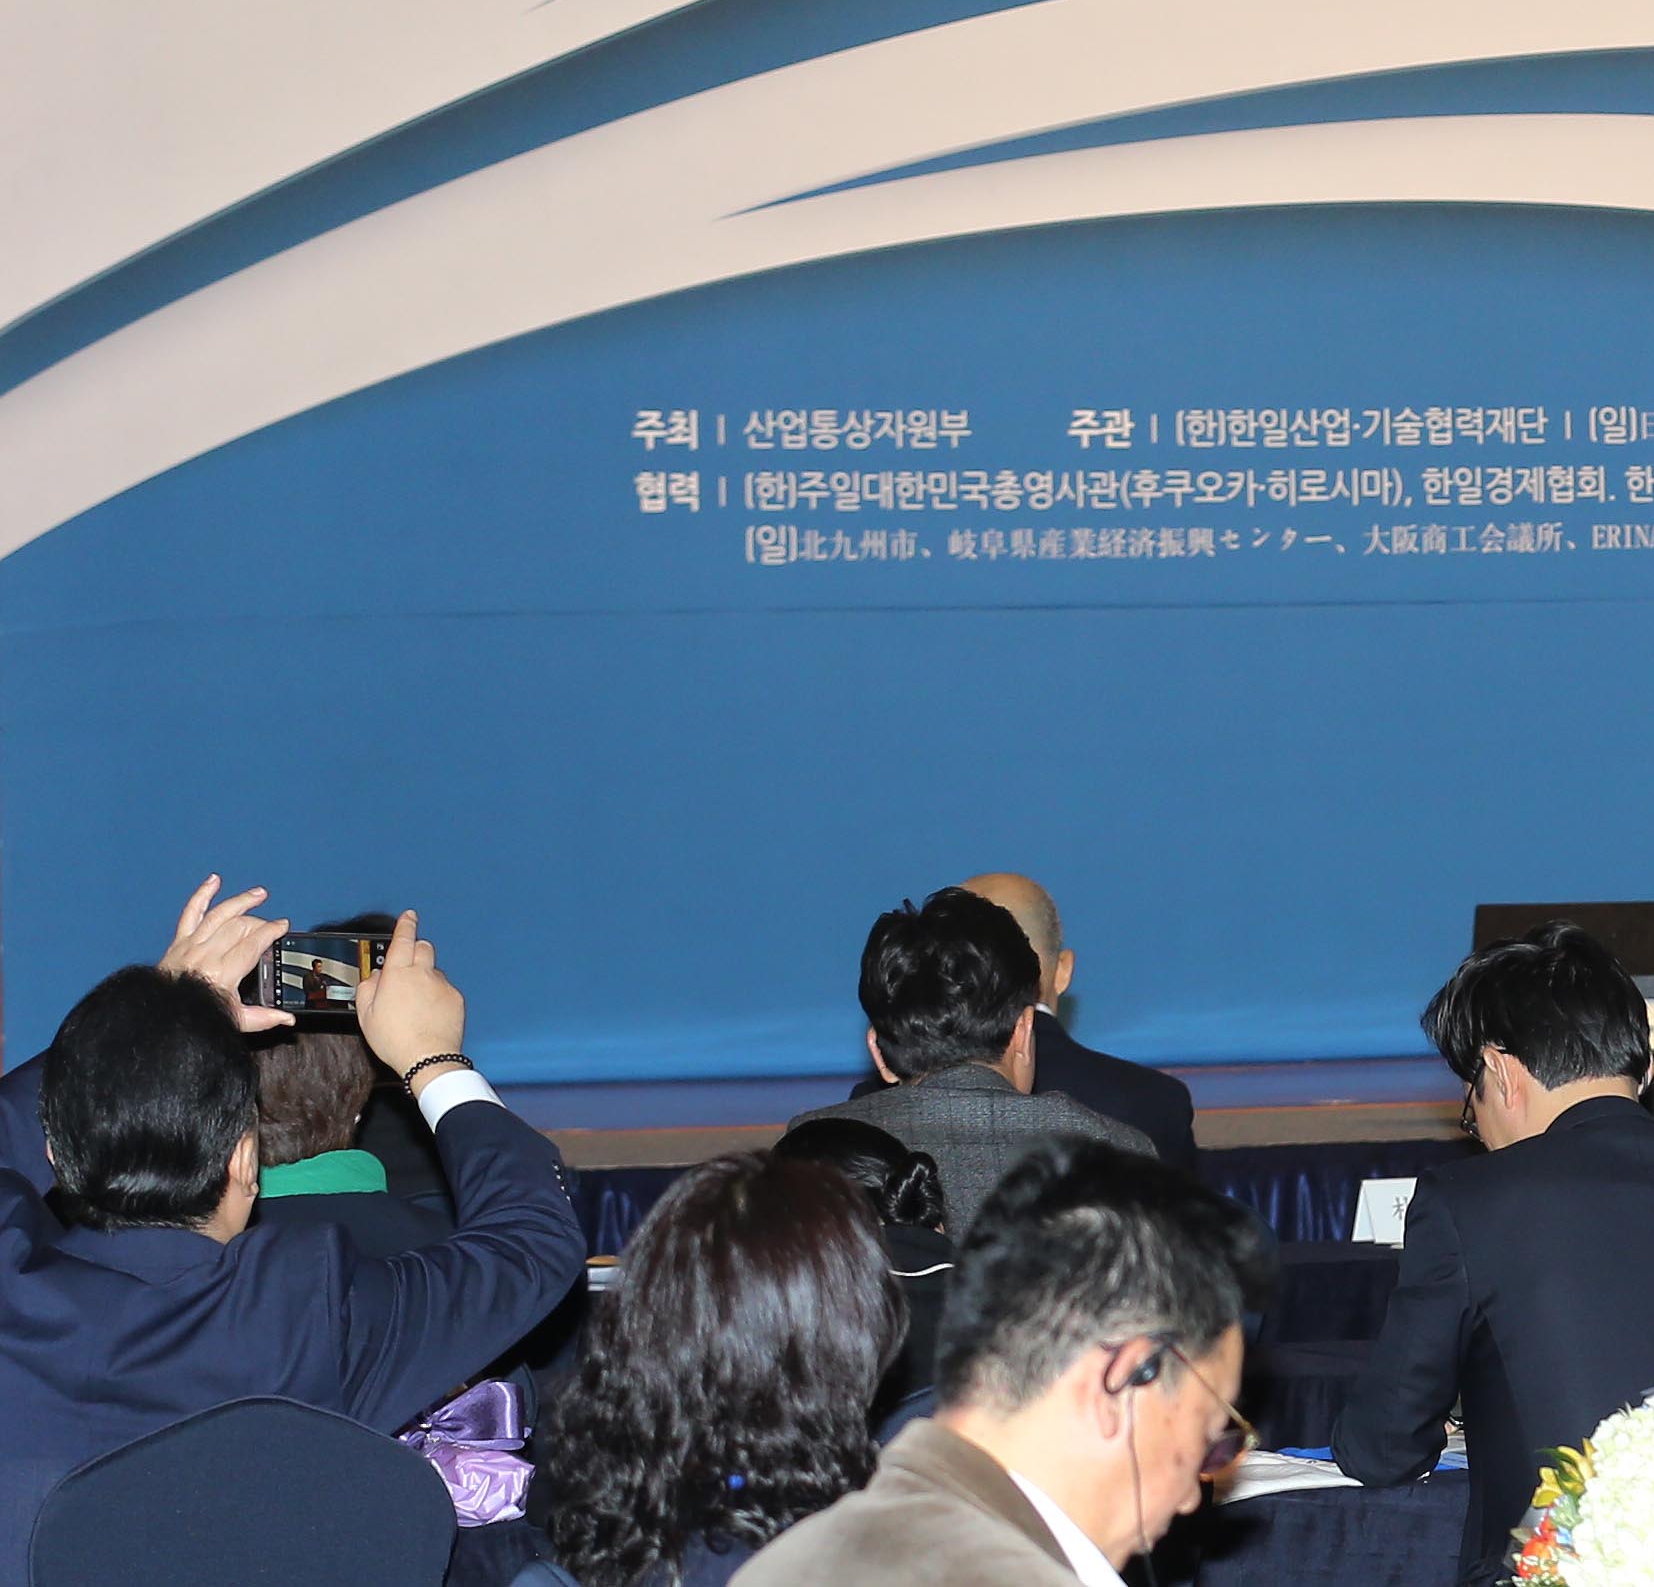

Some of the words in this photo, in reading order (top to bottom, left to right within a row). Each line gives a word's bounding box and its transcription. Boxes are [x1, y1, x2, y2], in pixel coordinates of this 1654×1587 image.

[631, 408, 699, 451] 주최
[743, 408, 973, 451] 산업통상자원부
[1066, 407, 1136, 450] 주관
[633, 470, 701, 513] 협력
